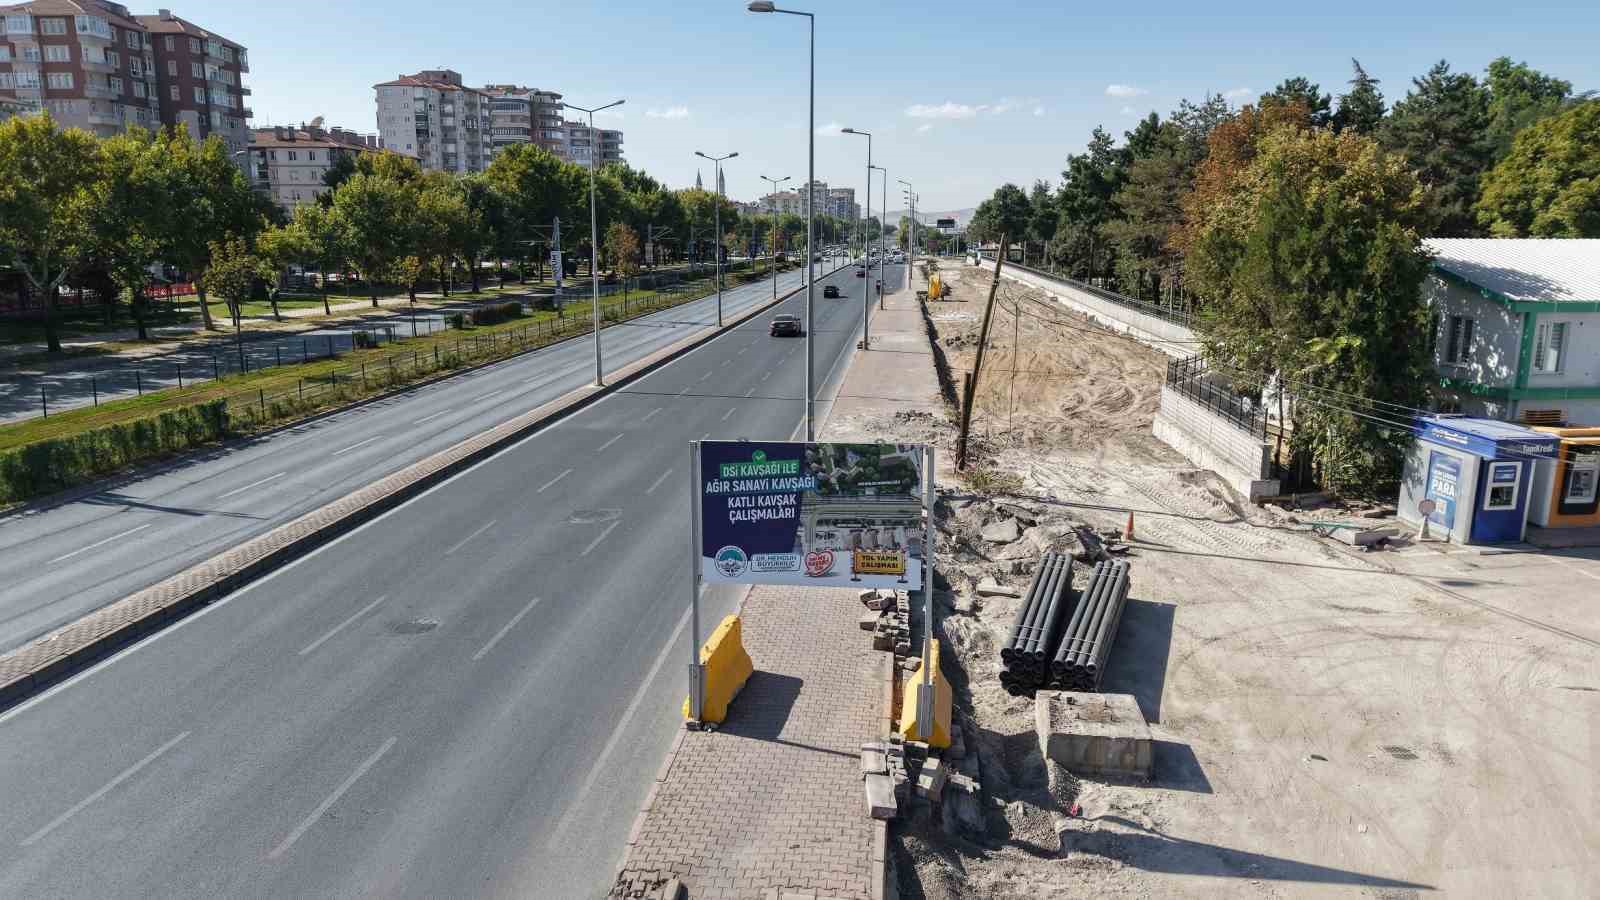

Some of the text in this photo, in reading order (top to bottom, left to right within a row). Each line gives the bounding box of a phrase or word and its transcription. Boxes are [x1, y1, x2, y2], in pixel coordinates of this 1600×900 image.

[740, 461, 780, 478] KAVŞAĞI
[705, 474, 815, 493] AĞIR SANAYİ KAVŞAĞI
[1431, 480, 1455, 497] PARA
[728, 494, 797, 509] KATLI KAVŞAK
[729, 507, 795, 525] ÇALIŞMALARI
